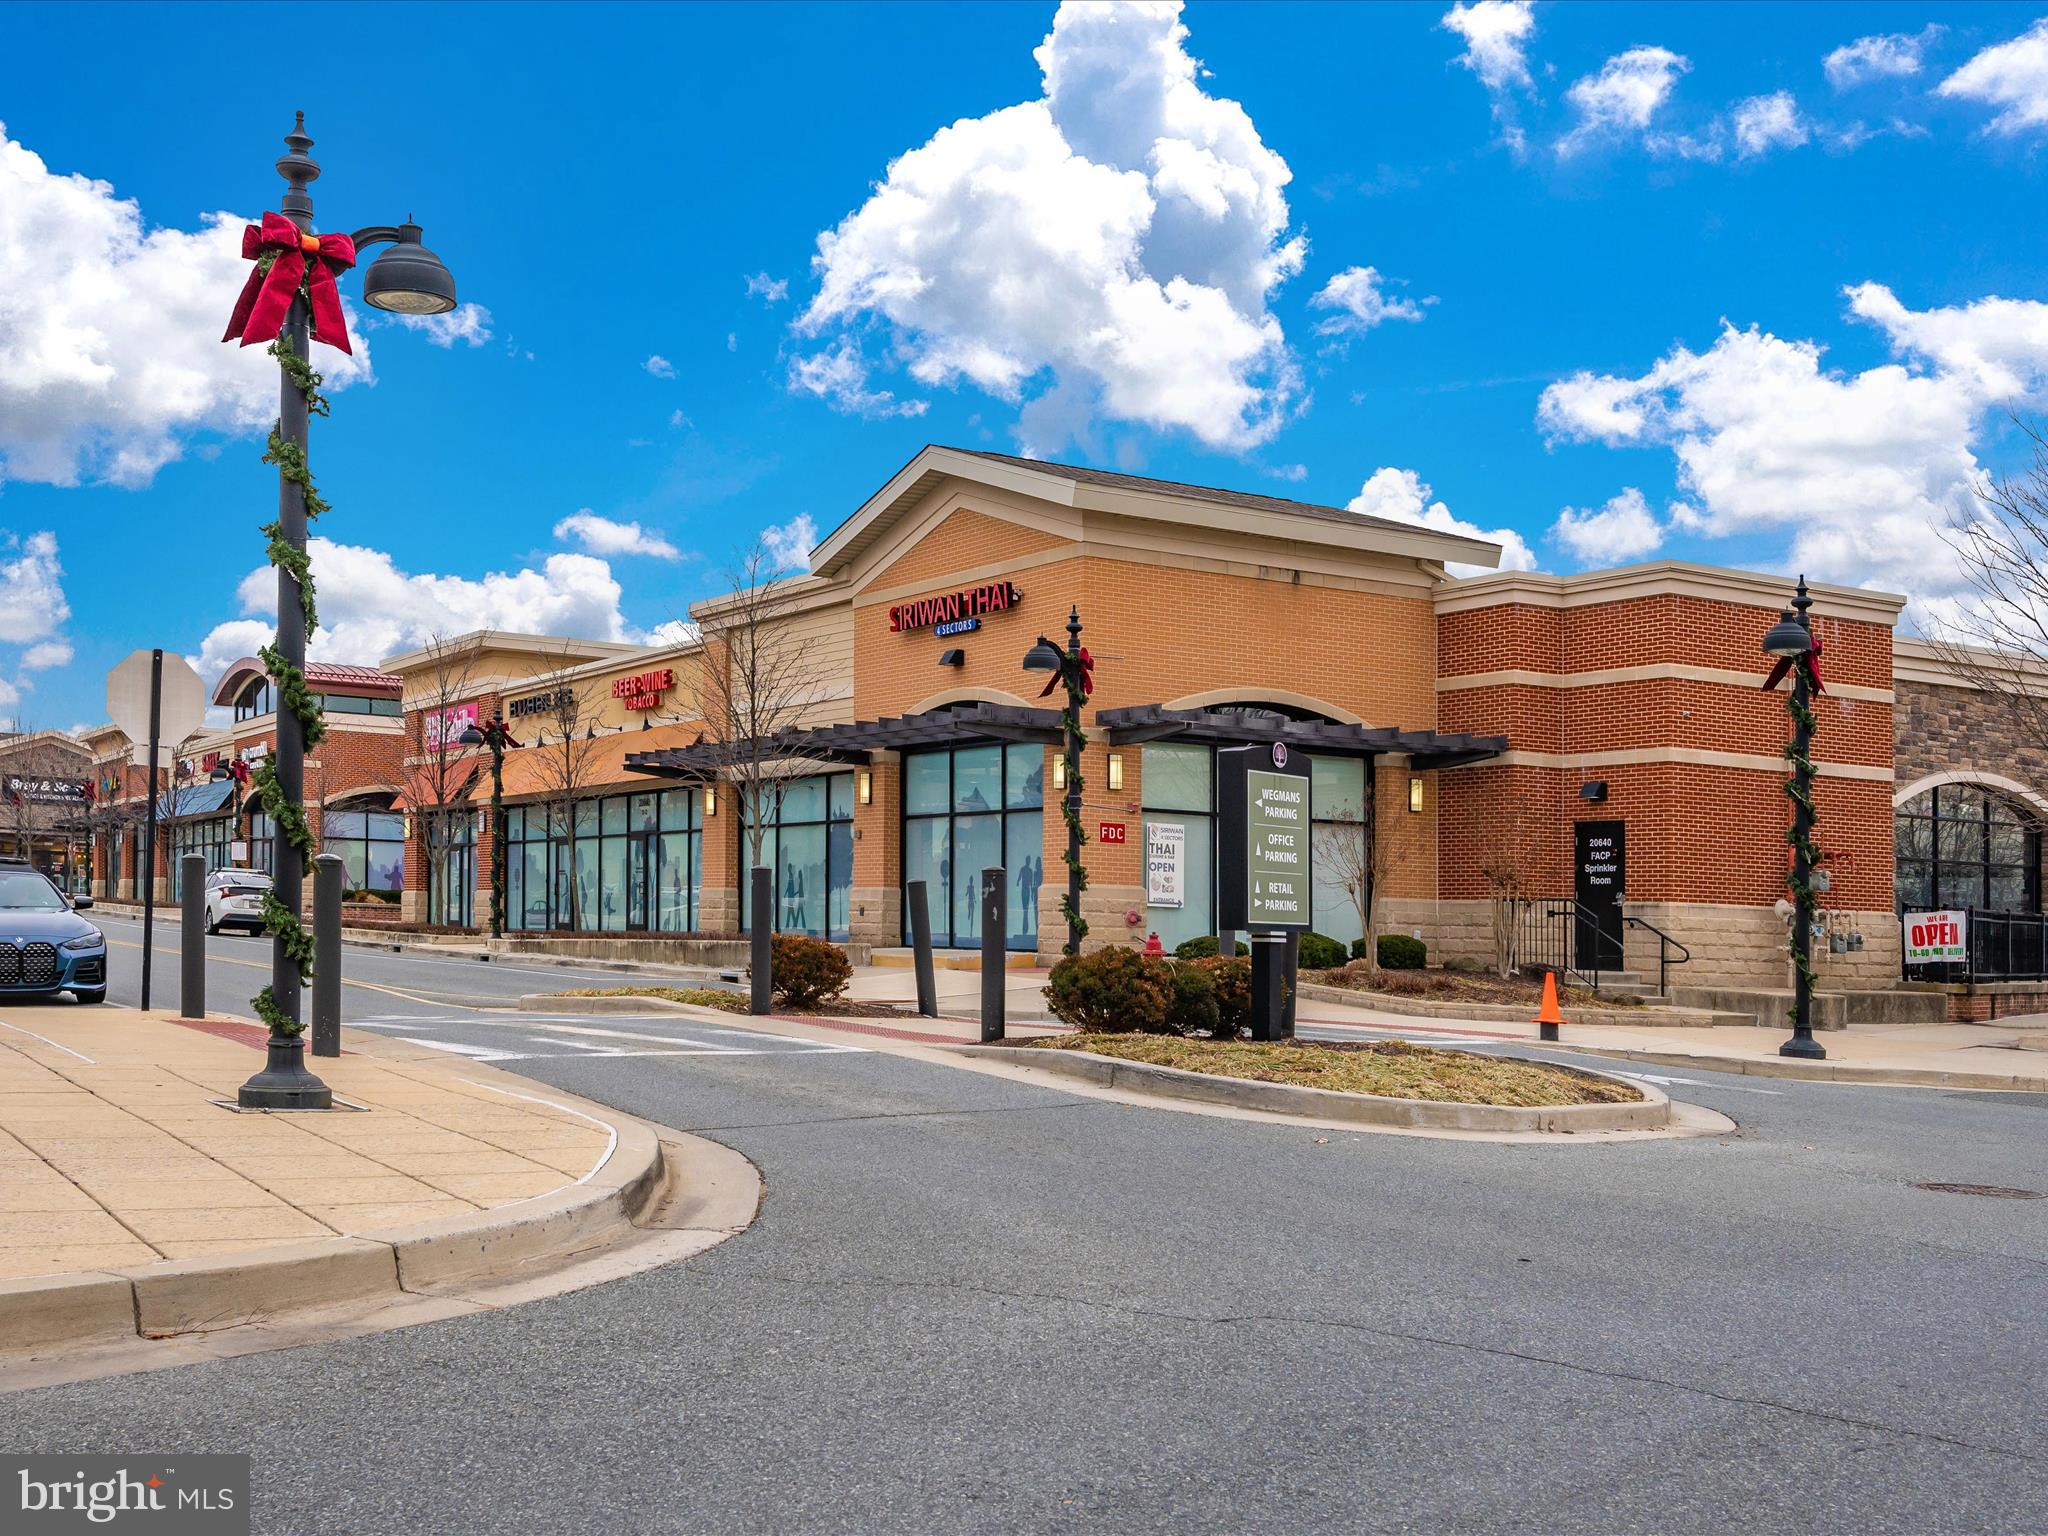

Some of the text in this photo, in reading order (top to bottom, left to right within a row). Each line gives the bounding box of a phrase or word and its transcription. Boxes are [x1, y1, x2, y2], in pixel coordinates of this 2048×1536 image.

[889, 580, 1010, 632] SIRIWAN THAI
[942, 622, 972, 635] SECTORS
[624, 694, 656, 711] TOBACCO
[41, 781, 50, 791] &
[1261, 788, 1301, 804] WEGMANS
[1264, 806, 1298, 820] PARKING
[1101, 826, 1124, 840] FDC
[1160, 827, 1184, 835] SIRIWAN
[1268, 833, 1295, 847] OFFICE
[1589, 838, 1612, 847] 20640
[1149, 843, 1175, 855] THAI
[1590, 851, 1611, 860] FACP
[1264, 850, 1298, 864] PARKING
[1149, 862, 1175, 873] OPEN
[1584, 864, 1617, 874] Sprinkler
[1590, 876, 1612, 885] Room
[1268, 882, 1294, 895] RETAIL
[1265, 899, 1298, 912] PARKING
[1911, 922, 1959, 947] OPEN
